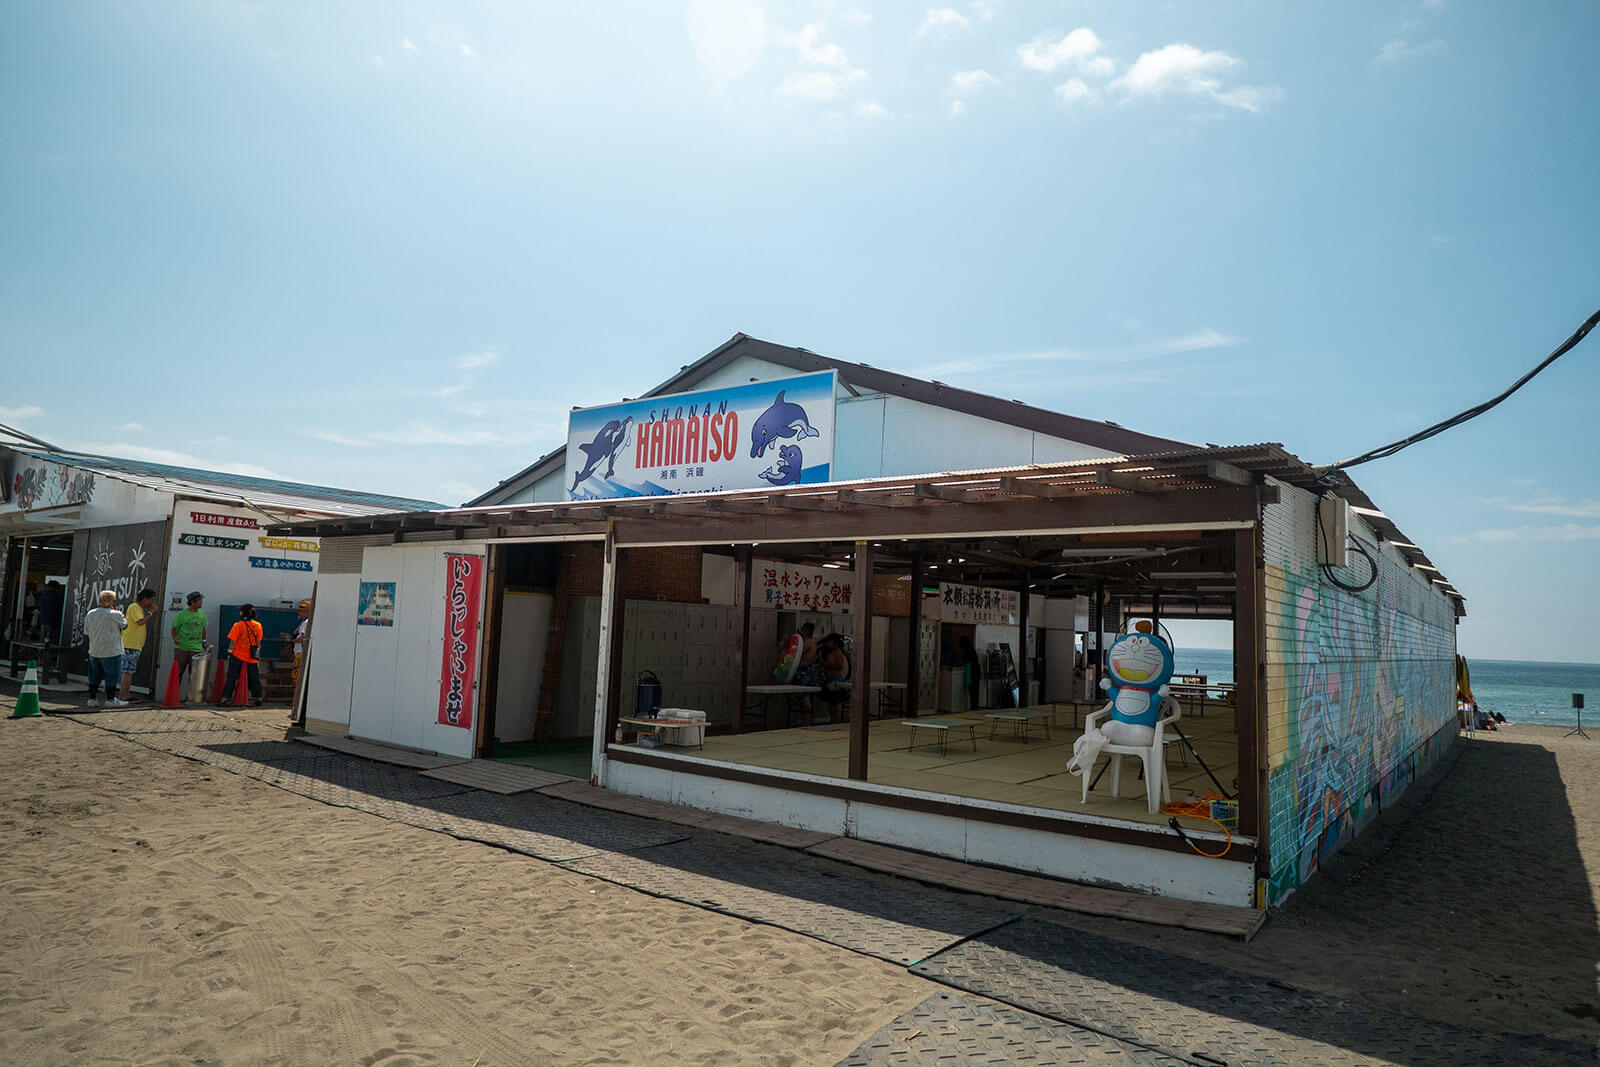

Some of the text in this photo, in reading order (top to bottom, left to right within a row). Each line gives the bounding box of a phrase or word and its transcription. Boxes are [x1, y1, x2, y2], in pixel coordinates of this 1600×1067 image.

[649, 400, 728, 424] SHONAN
[635, 410, 738, 469] HAMAISO
[659, 469, 678, 480] 湘南
[763, 567, 829, 590] 温水シャワー
[446, 558, 470, 724] いらっしゃいませ
